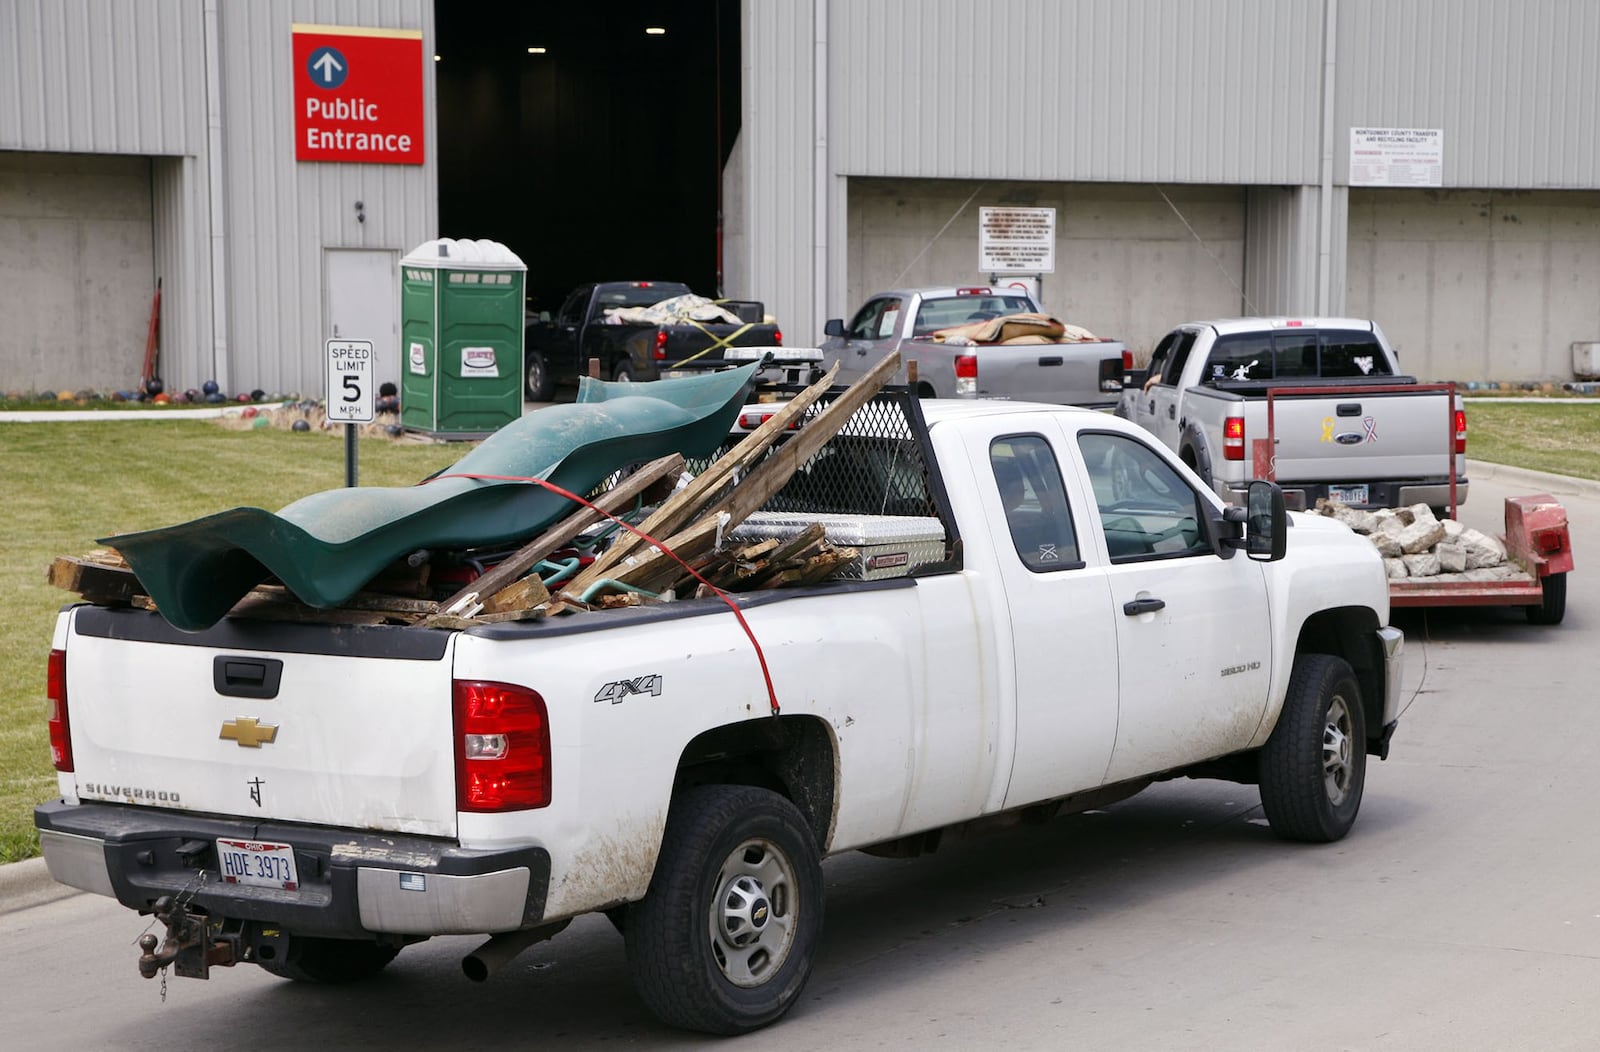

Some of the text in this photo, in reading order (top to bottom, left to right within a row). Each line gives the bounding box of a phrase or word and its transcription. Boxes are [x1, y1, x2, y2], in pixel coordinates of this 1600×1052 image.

[306, 97, 378, 121] Public
[307, 127, 411, 152] Entrance
[332, 348, 369, 359] SPEED
[336, 361, 366, 371] LIMIT
[343, 375, 361, 402] 5
[85, 783, 181, 802] SILVERADO
[245, 843, 264, 851] OHIO
[223, 852, 291, 881] HDE 3973
